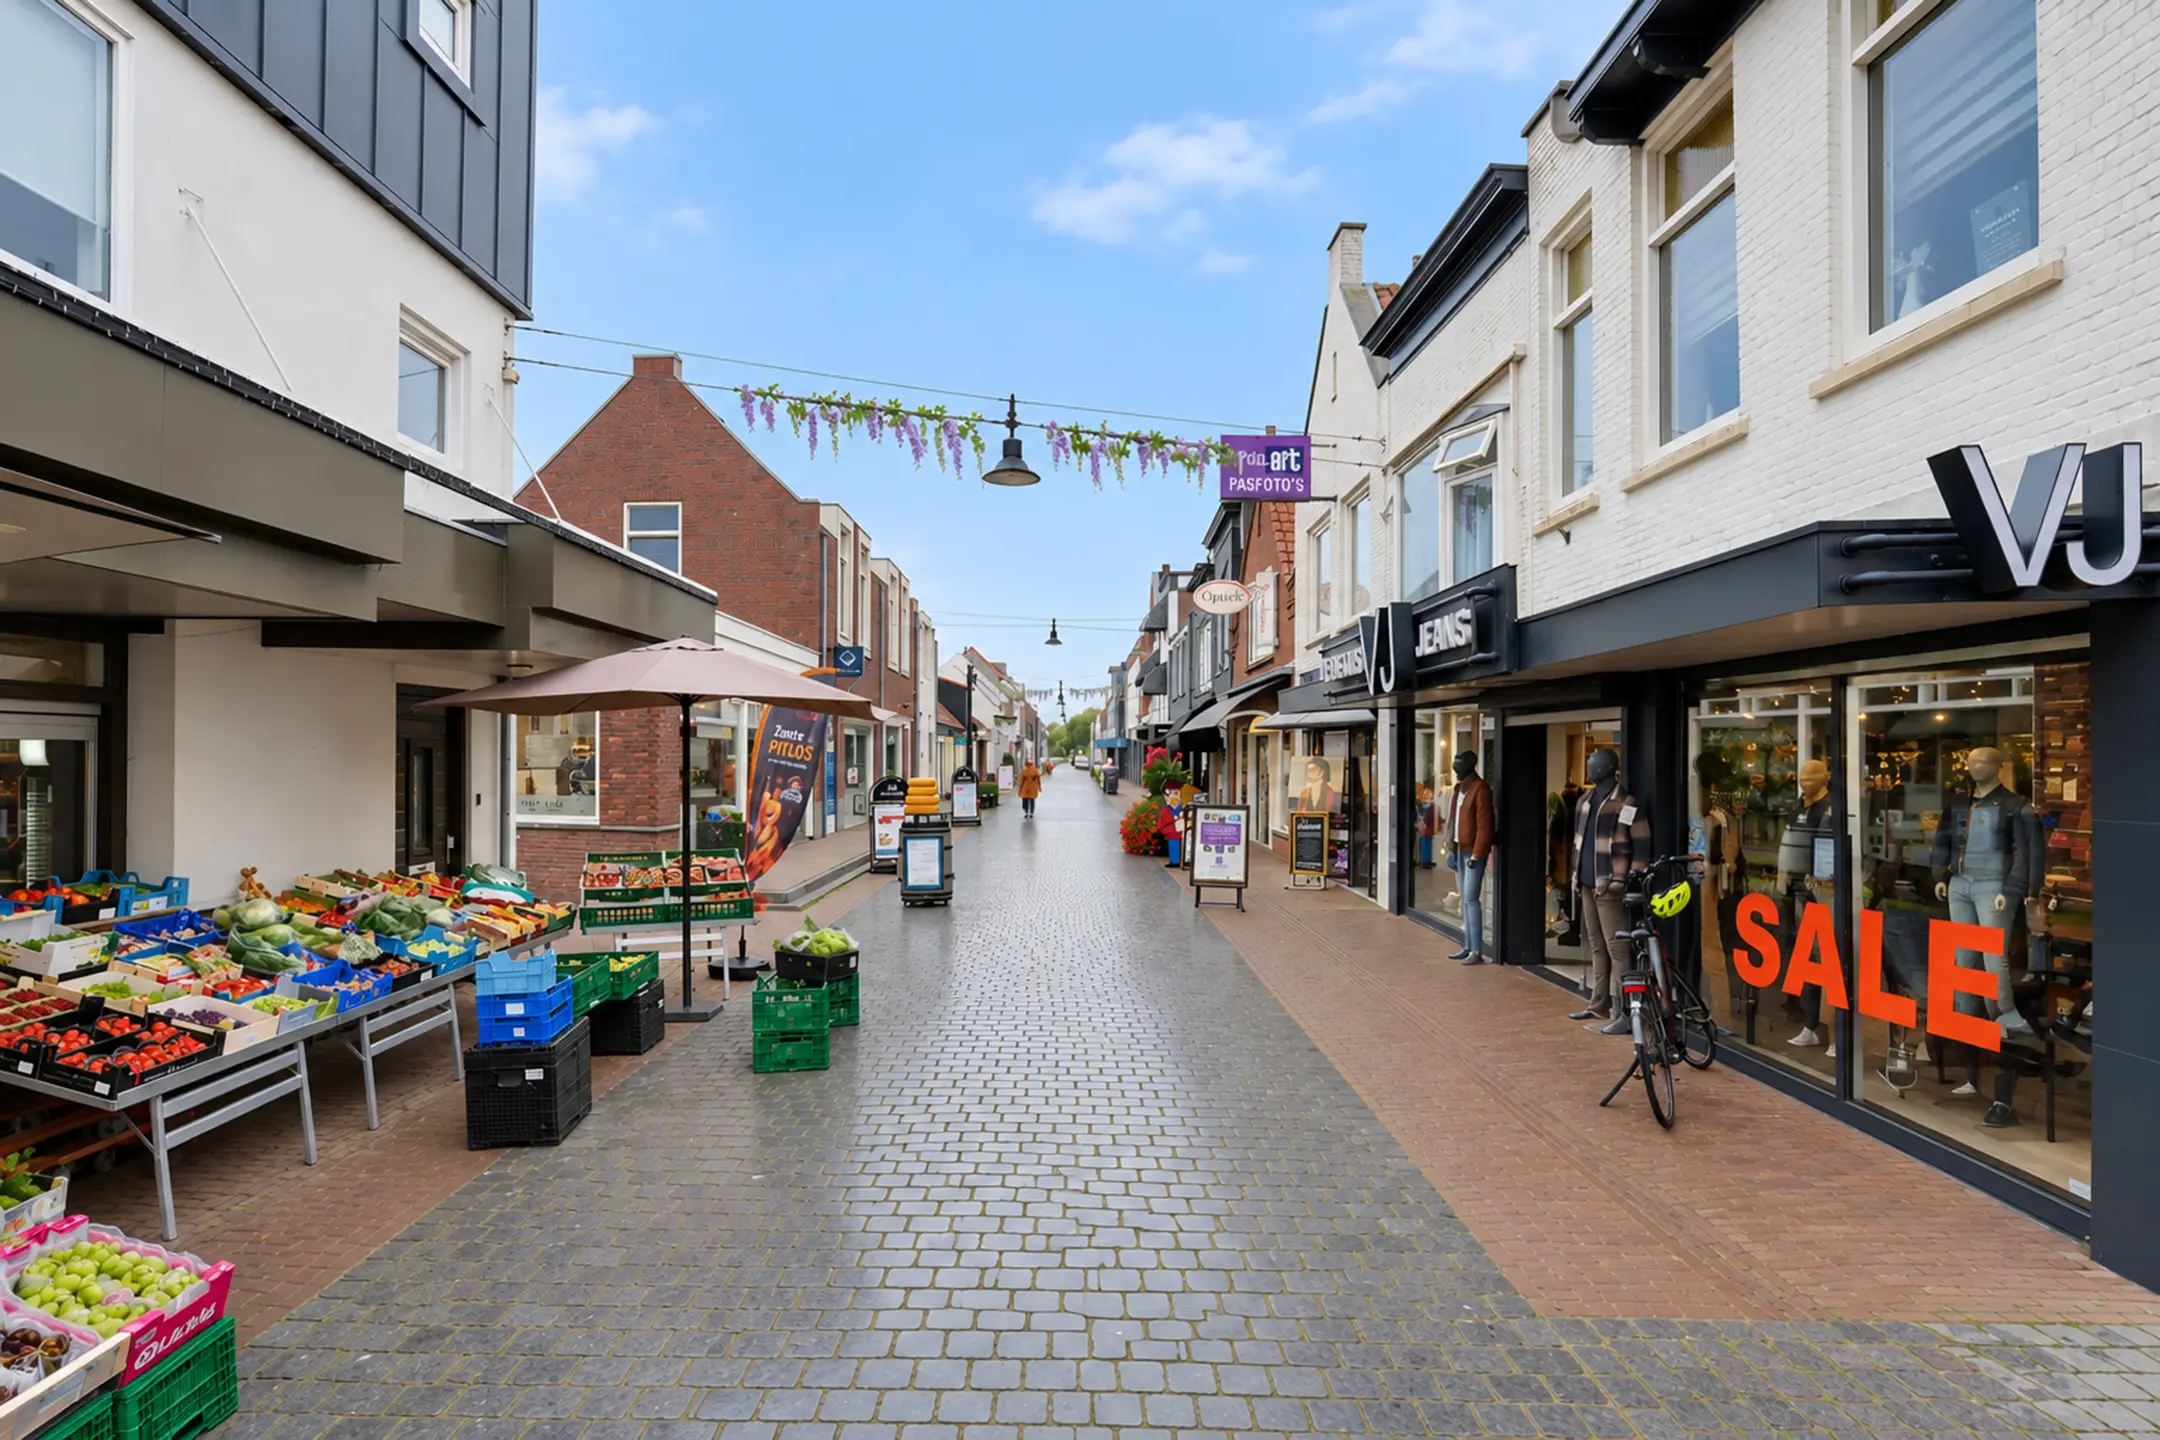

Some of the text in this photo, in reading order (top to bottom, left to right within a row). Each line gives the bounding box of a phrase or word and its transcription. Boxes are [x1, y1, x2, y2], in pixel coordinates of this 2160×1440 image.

[1229, 476, 1305, 493] PASFOTO'S
[1927, 442, 2142, 589] VJ
[1359, 602, 1412, 697] VJ
[1415, 607, 1472, 658] JEANS
[767, 739, 815, 762] PITLOS
[1732, 892, 2005, 1053] SALE
